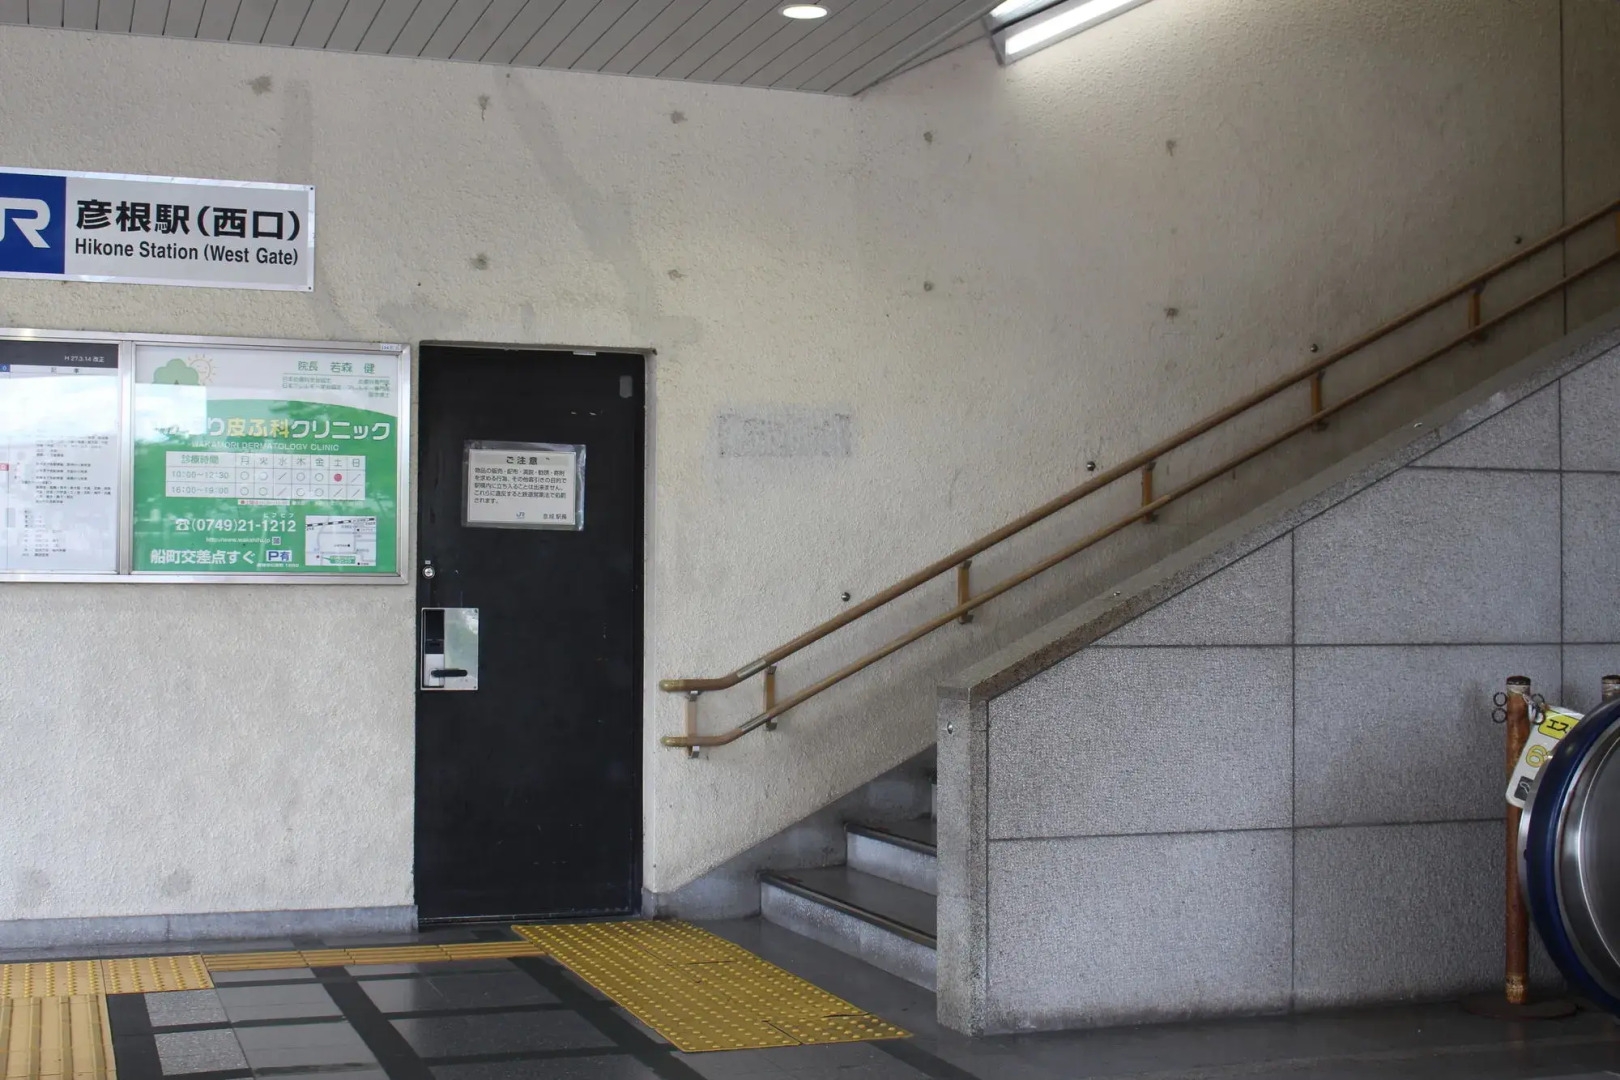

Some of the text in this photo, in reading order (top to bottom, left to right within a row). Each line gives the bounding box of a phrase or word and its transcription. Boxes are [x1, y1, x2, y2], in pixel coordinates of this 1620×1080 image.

[75, 199, 301, 241] 彦根駅（西口）
[75, 238, 299, 266] Hikone Station (West Gate)
[298, 361, 375, 375] 院長 若森 健
[242, 441, 308, 451] DERMATOLOGY
[310, 442, 340, 452] CLINIC
[180, 454, 361, 468] 診療時間 月 火 水 木 金 土 日
[506, 456, 538, 465] ご注意
[191, 518, 297, 533] (0749)21-1212
[150, 549, 256, 565] 船町交差点すぐ
[1547, 719, 1572, 733] エス
